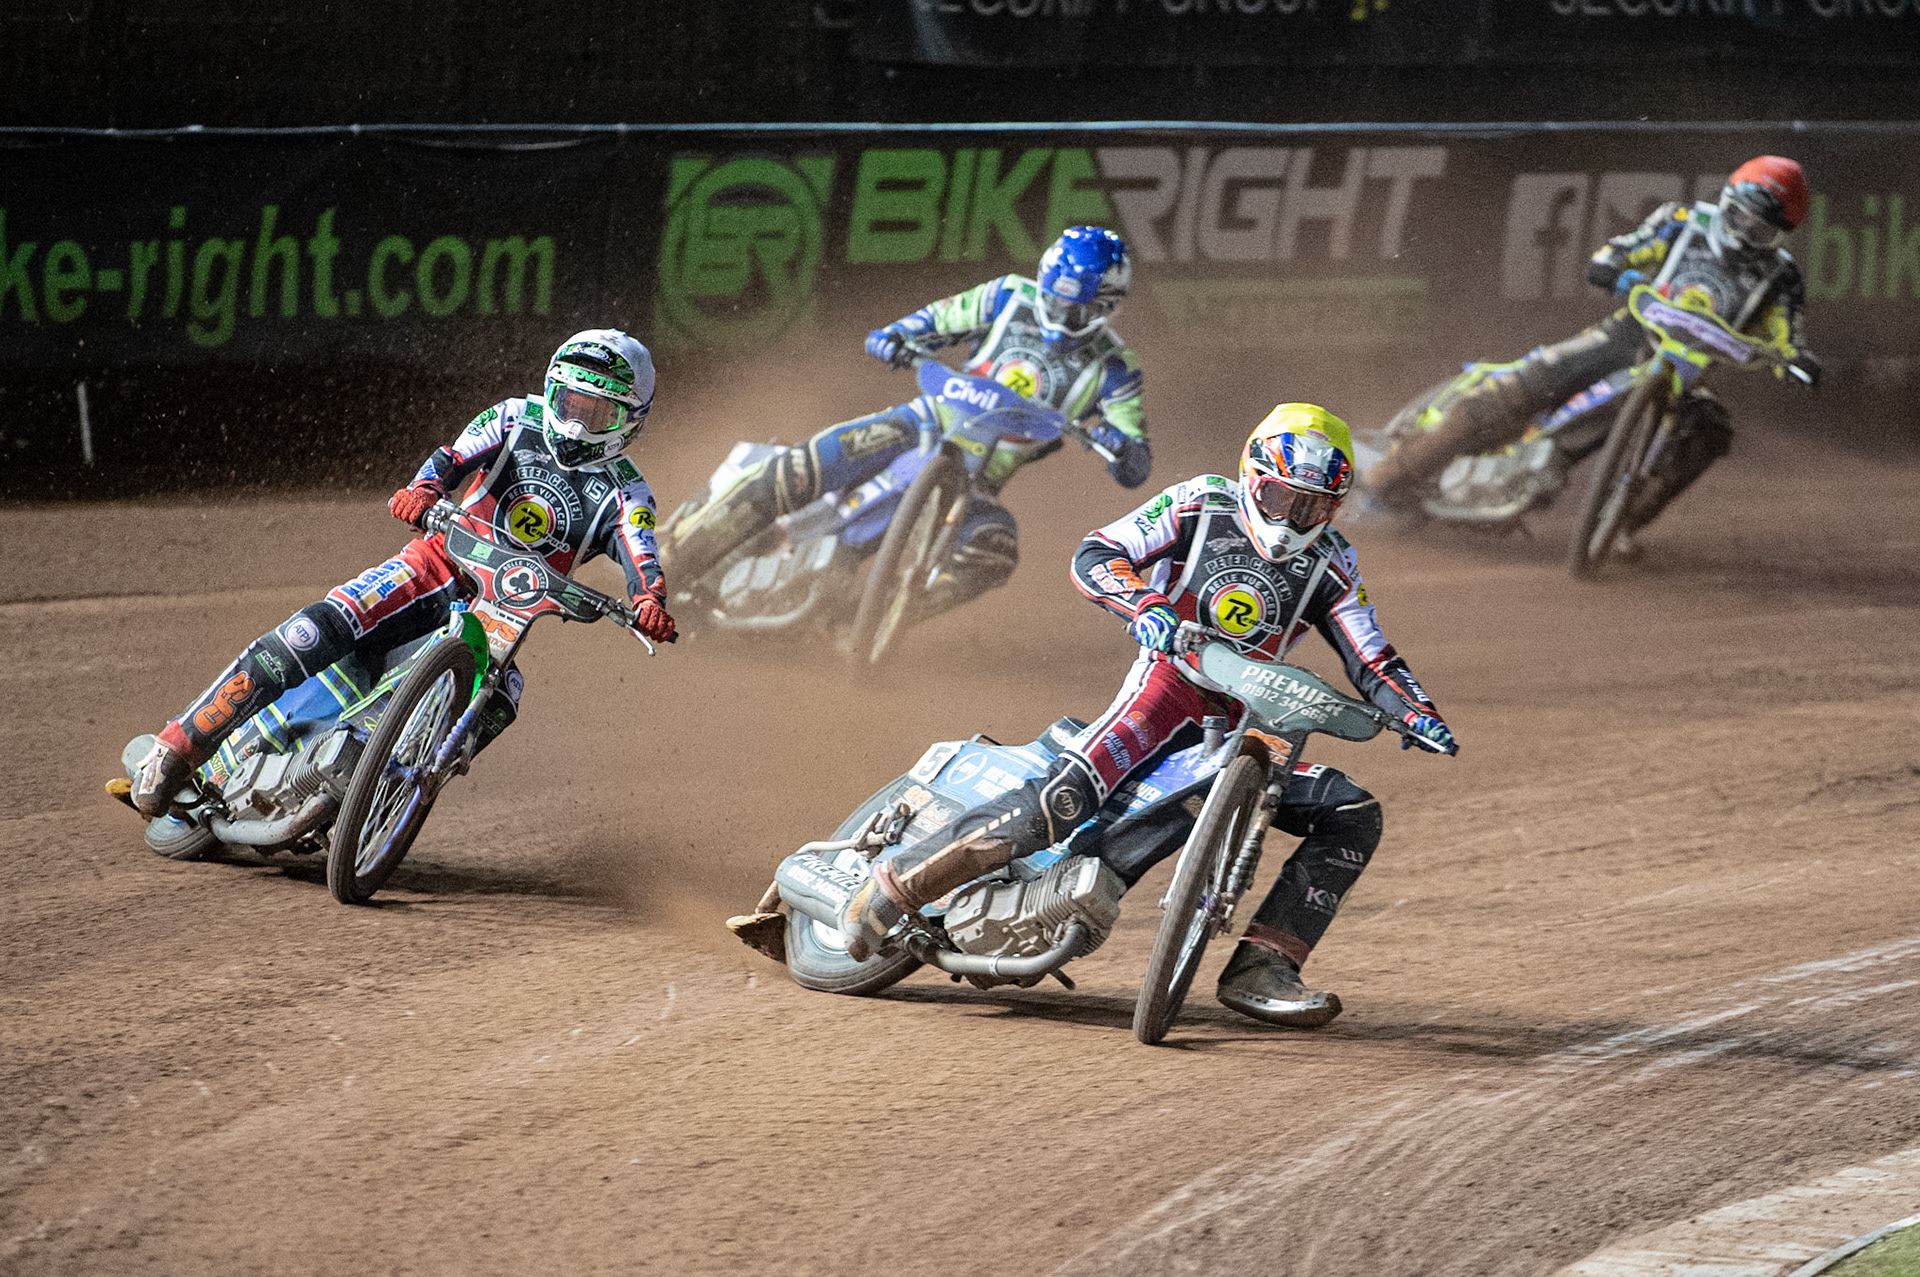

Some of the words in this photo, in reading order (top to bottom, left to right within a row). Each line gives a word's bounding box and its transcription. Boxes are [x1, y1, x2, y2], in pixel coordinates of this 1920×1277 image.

[943, 377, 999, 411] Civil
[510, 466, 549, 481] PETER
[548, 473, 583, 521] CRAVEN
[584, 477, 606, 501] 15
[508, 485, 535, 500] BELLE
[540, 485, 559, 504] VUE
[555, 506, 566, 532] ACES
[502, 560, 523, 571] BELLE
[526, 562, 539, 572] VUE
[1204, 554, 1249, 574] PETER
[1290, 555, 1309, 575] 2
[376, 579, 396, 599] plc
[1207, 573, 1239, 594] BELLE
[1242, 574, 1261, 589] VUE
[293, 624, 312, 643] ATPI
[1240, 665, 1346, 717] PREMIER
[1240, 682, 1280, 703] 01912
[1106, 731, 1124, 753] BLUE
[918, 746, 953, 777] 5
[1101, 738, 1125, 770] PROJECT
